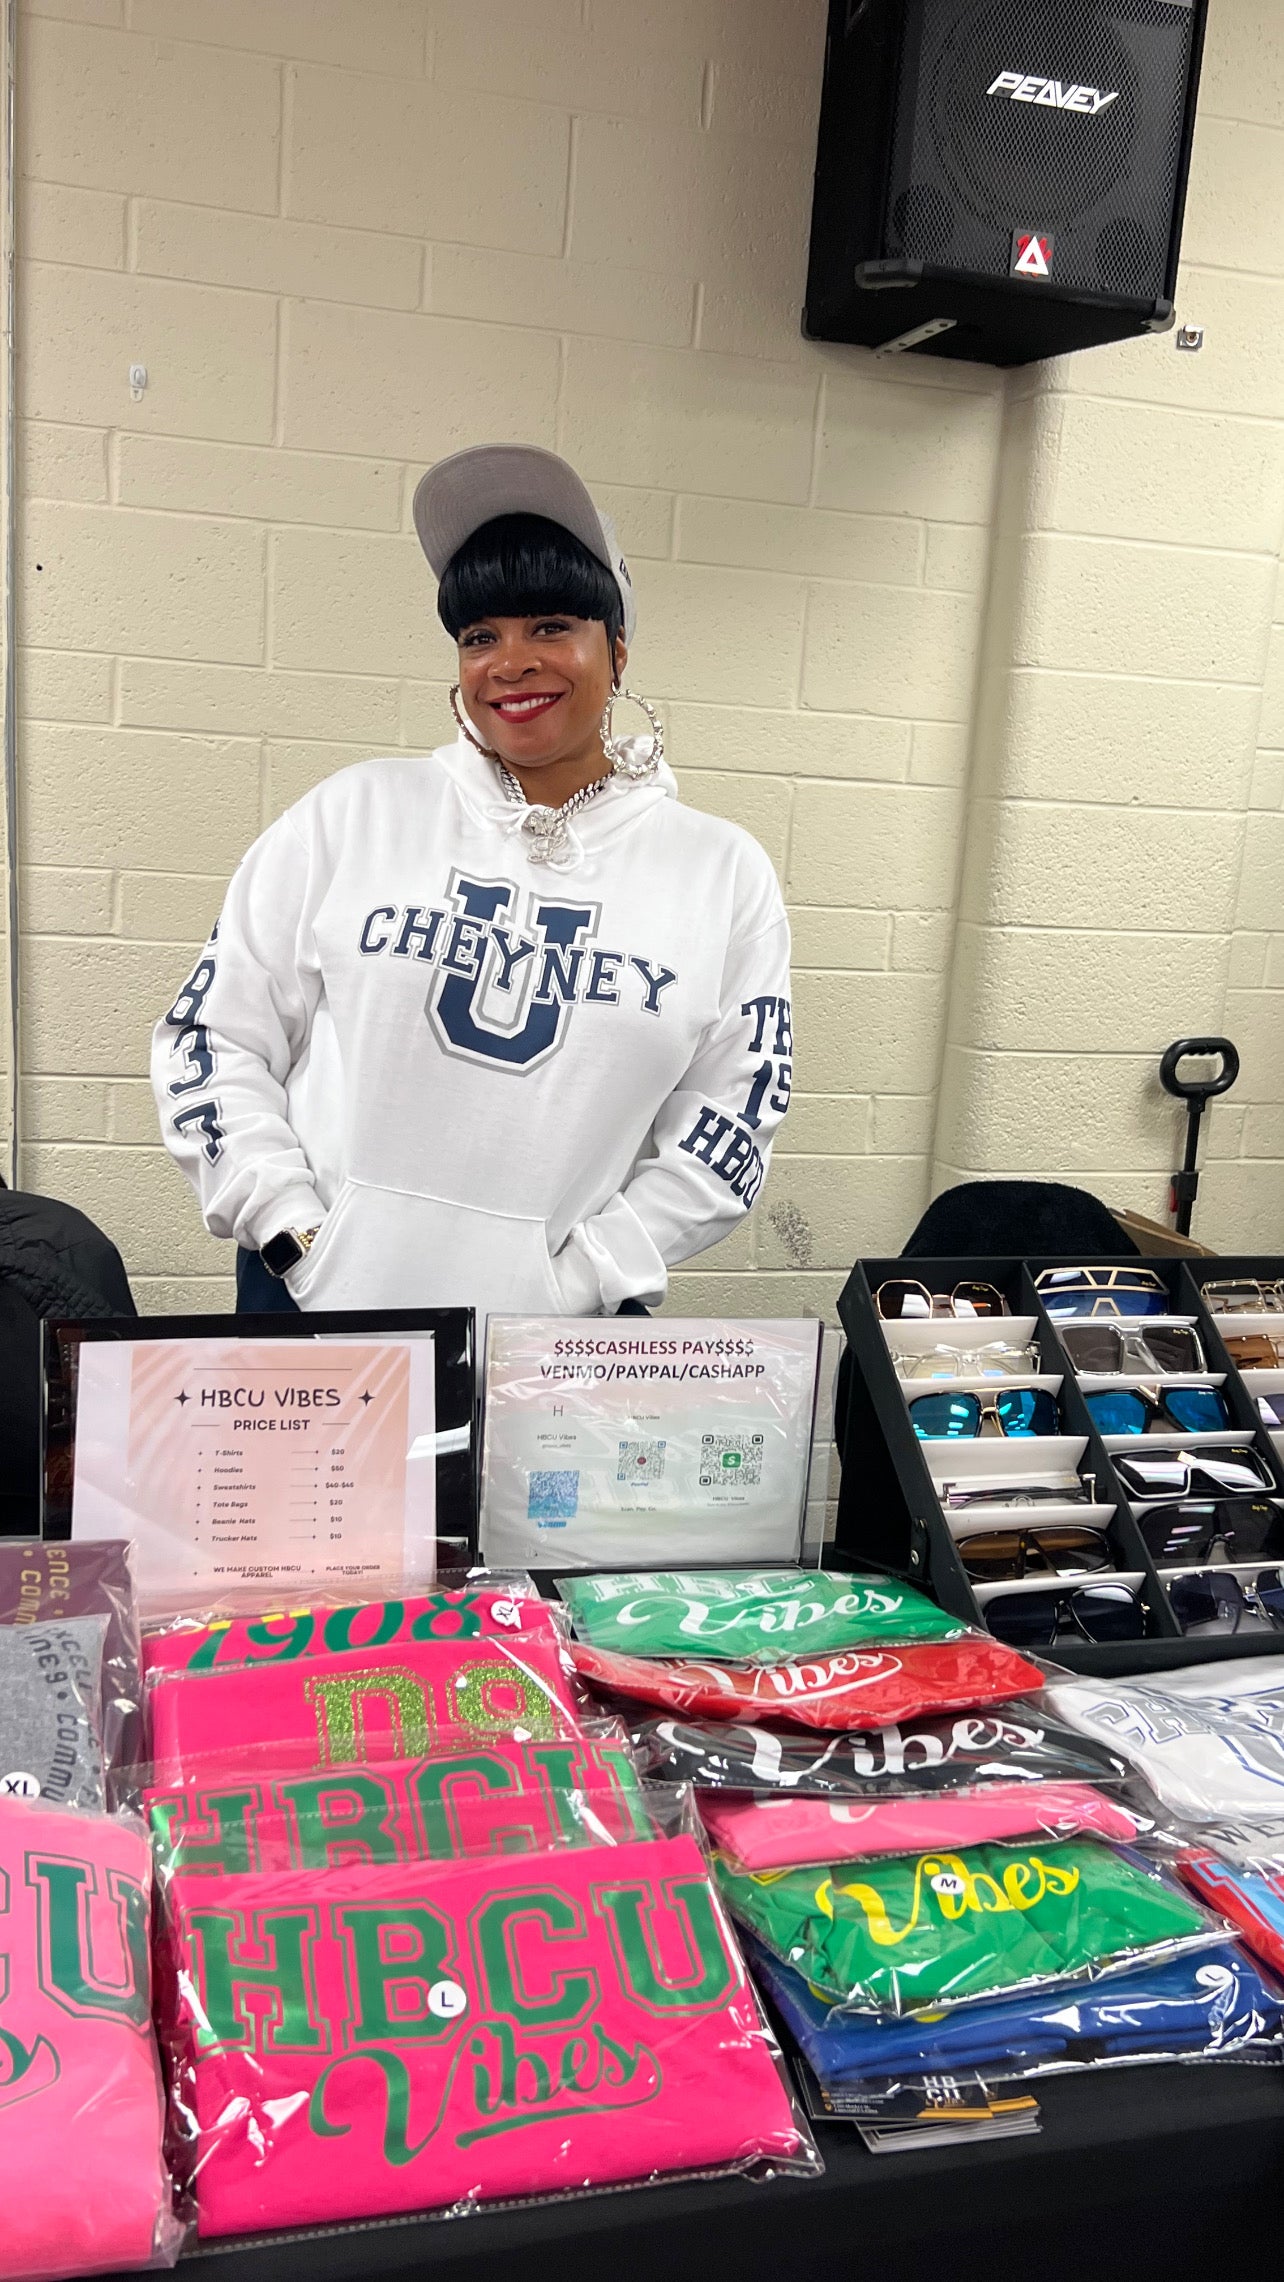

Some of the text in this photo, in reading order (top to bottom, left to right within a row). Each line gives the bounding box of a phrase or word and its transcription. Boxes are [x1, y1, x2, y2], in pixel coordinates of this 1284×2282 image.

[986, 71, 1119, 114] PEAVEY
[358, 904, 678, 1017] CHEYNEY
[741, 996, 792, 1057] TH
[164, 916, 226, 1168] 837
[554, 1339, 755, 1357] $$$$CASHLESS PAY$$$$
[540, 1363, 765, 1381] VENMO/PAYPAL/CASHAPP
[201, 1387, 341, 1408] HBCU VIBES
[553, 1405, 563, 1417] H
[233, 1419, 311, 1431] PRICE LIST
[331, 1448, 345, 1456] $20
[231, 1501, 248, 1509] Bags
[616, 1588, 904, 1636] Vibes
[656, 1716, 1045, 1782] Vibes
[5, 1779, 35, 1796] XL
[940, 1875, 957, 1890] M
[814, 1854, 1080, 1946] Vibes
[182, 1876, 742, 2058] HBCU
[441, 1990, 455, 2009] L
[307, 2020, 664, 2166] Vibes
